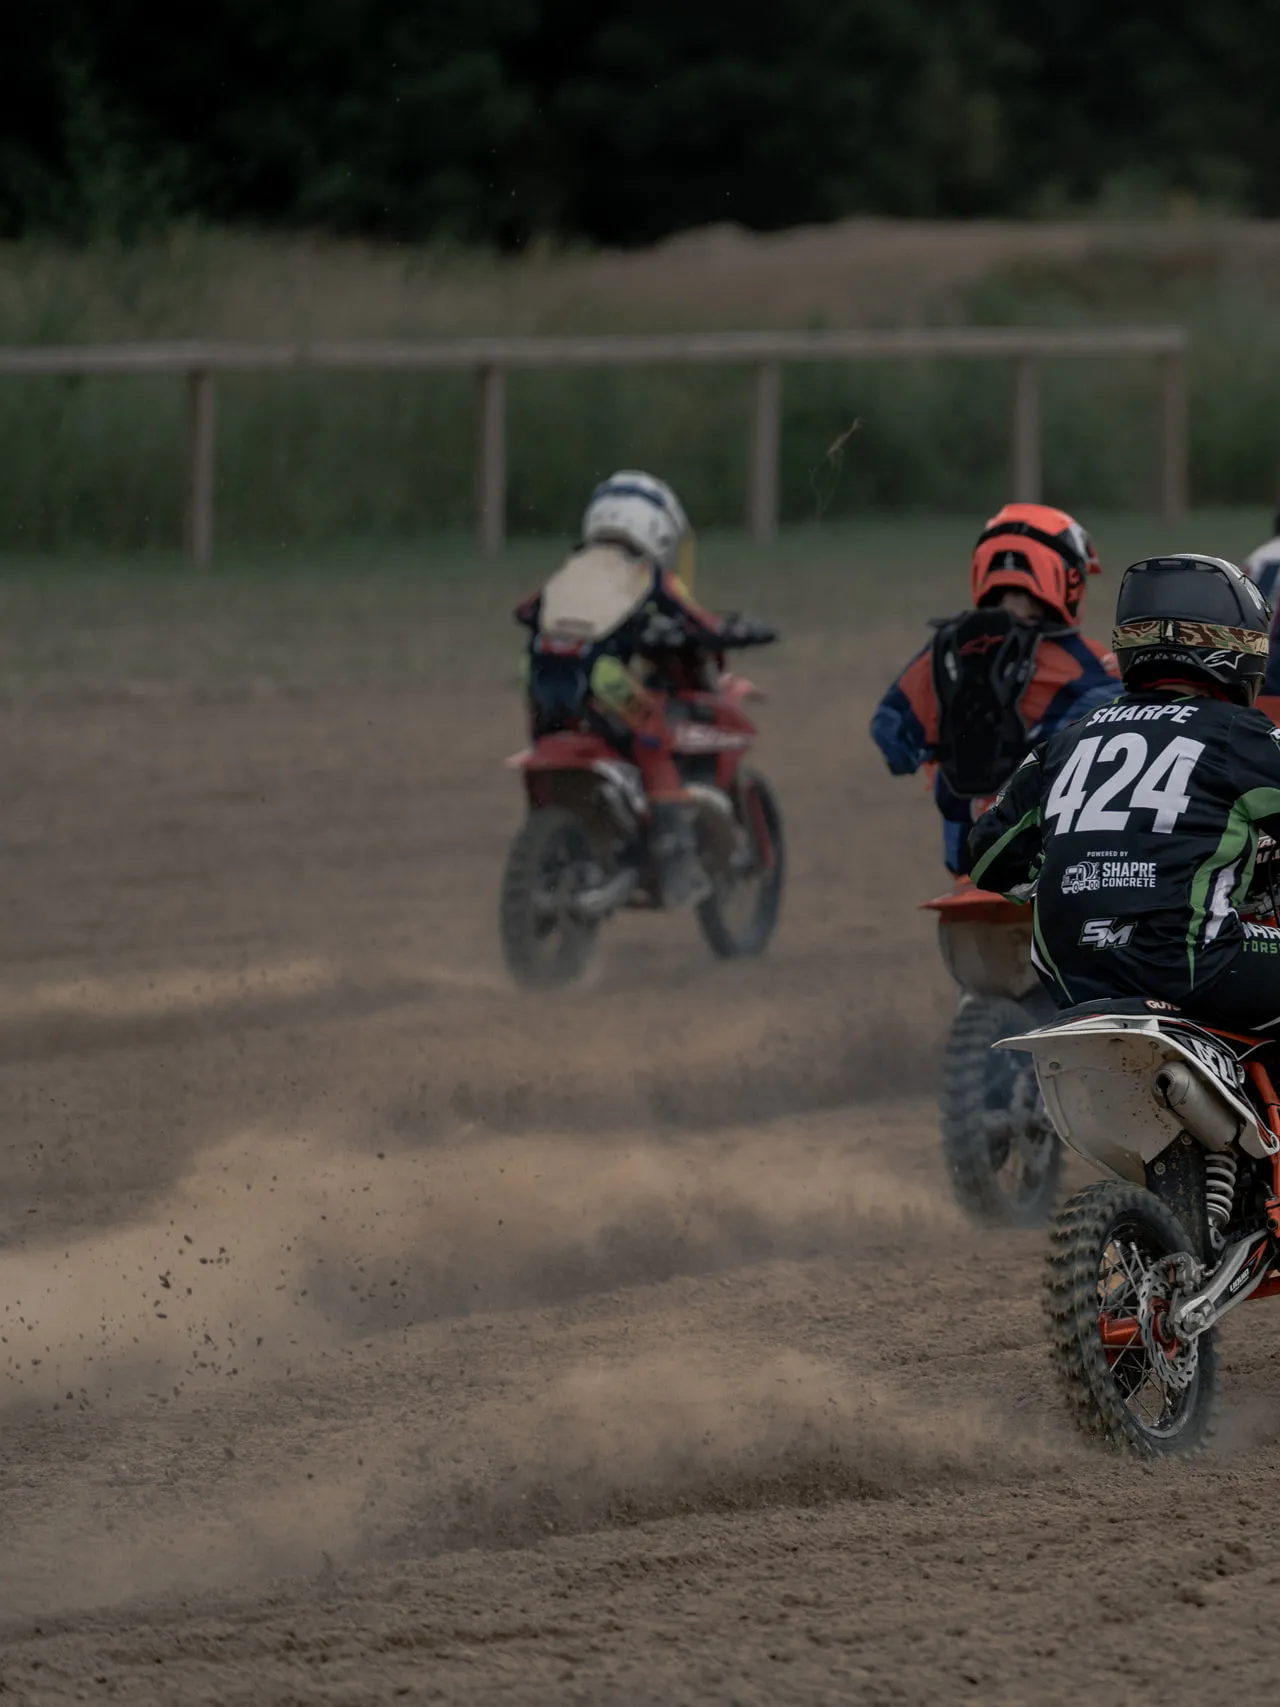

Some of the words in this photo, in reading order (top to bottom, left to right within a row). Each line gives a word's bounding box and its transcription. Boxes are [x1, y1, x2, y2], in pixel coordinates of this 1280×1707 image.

[1085, 704, 1200, 727] SHARPE
[1044, 732, 1206, 836] 424
[1102, 861, 1157, 878] SHAPRE
[1101, 877, 1157, 888] CONCRETE
